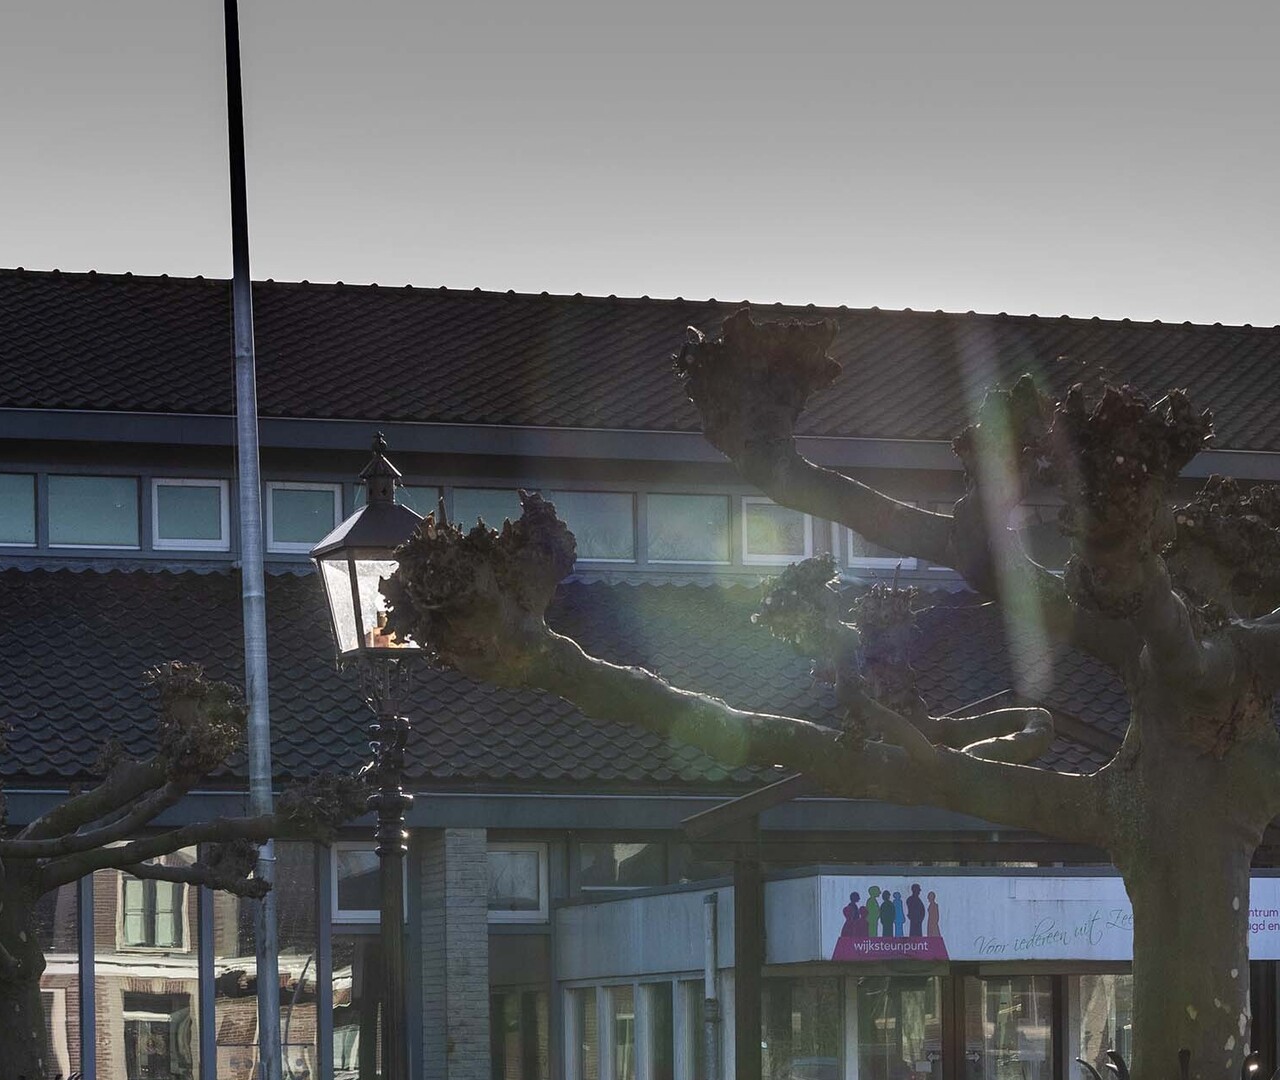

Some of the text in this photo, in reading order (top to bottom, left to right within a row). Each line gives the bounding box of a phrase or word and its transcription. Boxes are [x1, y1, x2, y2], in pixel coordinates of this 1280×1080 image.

[1250, 907, 1279, 918] ntrum
[974, 908, 1134, 955] Voor iedereen uit Zee
[1268, 923, 1280, 931] en
[854, 939, 929, 953] wijksteunpunt
